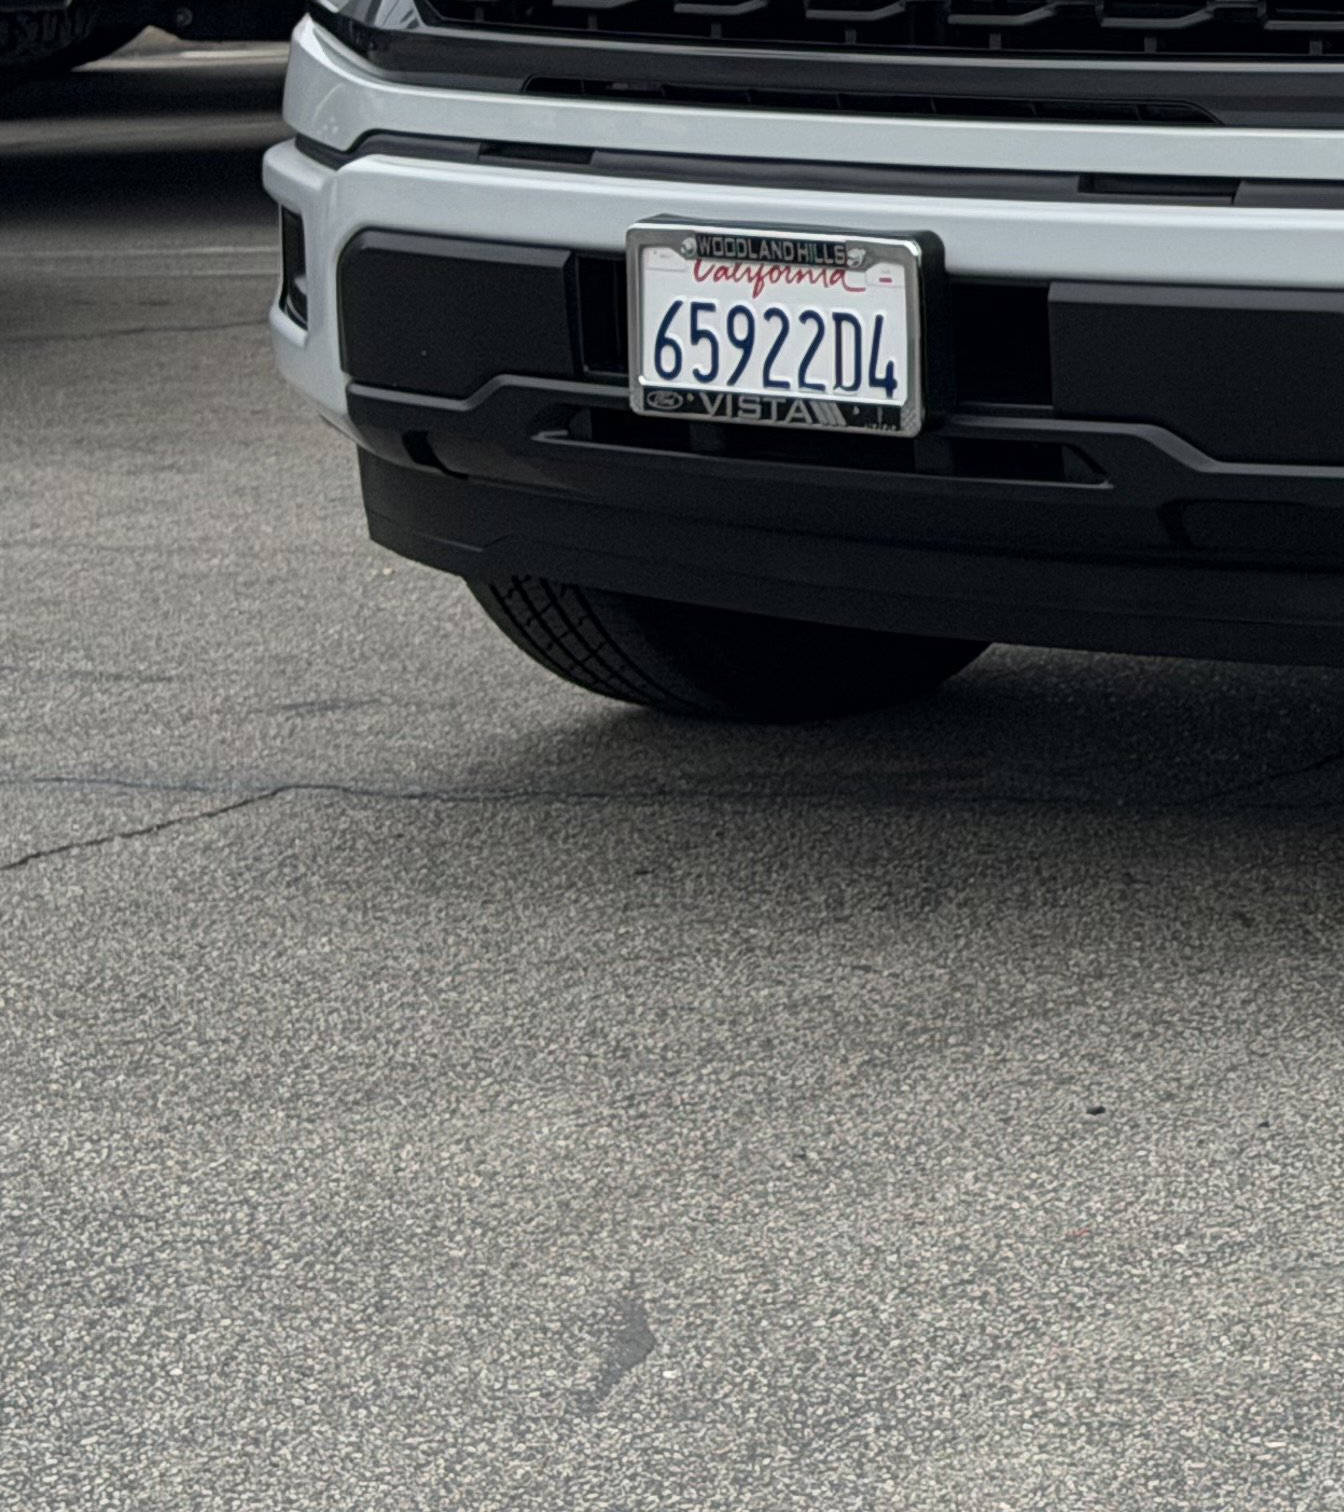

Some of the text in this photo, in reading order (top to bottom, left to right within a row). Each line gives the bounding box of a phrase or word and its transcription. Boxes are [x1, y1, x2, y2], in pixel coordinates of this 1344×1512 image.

[700, 237, 847, 265] WOODLAND HILLS
[693, 258, 867, 299] California
[653, 299, 898, 398] 65922D4
[700, 391, 814, 425] VISTA
